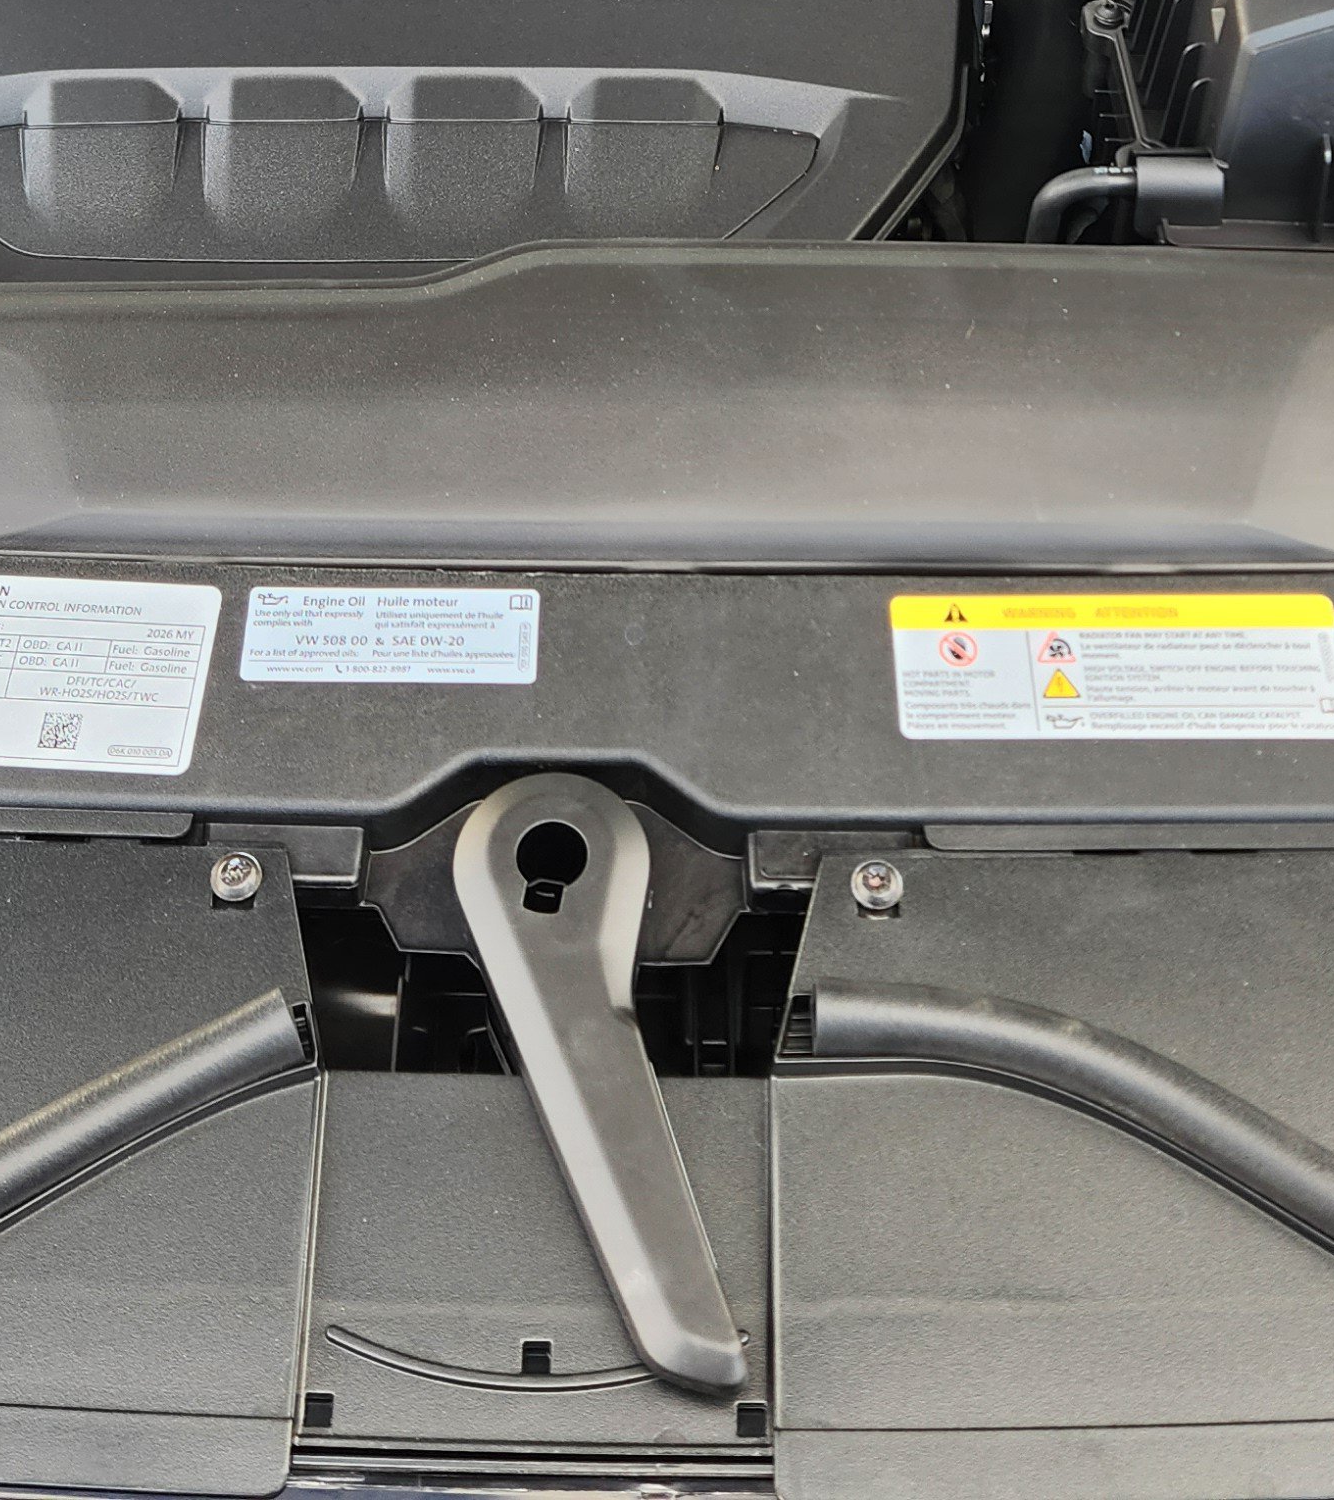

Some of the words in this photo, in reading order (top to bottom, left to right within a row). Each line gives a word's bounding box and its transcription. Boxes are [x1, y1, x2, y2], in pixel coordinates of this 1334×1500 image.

[9, 600, 60, 612] CONTROL
[64, 603, 142, 616] INFORMATION
[303, 596, 345, 609] Engine
[348, 596, 366, 606] Oil
[377, 596, 409, 607] Huile
[413, 598, 459, 607] moteur
[272, 610, 291, 618] only
[325, 611, 363, 620] expressly
[410, 612, 463, 621] uniquement
[253, 620, 291, 629] complies
[375, 621, 389, 630] qui
[391, 620, 425, 629] satisfait
[428, 621, 487, 630] expressément
[489, 621, 495, 629] à
[147, 628, 173, 639] 2026
[176, 630, 195, 639] MY
[295, 635, 319, 645] VW
[323, 635, 347, 645] 508
[351, 636, 368, 645] 00
[375, 637, 385, 645] &
[392, 636, 417, 646] SAE
[420, 636, 465, 646] 0W-20
[23, 639, 50, 650] OBD:
[57, 641, 71, 651] CA
[113, 644, 137, 655] Fuel:
[144, 646, 190, 658] Gasoline
[299, 650, 340, 660] approved
[373, 650, 392, 658] Pour
[411, 650, 429, 658] liste
[19, 655, 46, 666] OBD:
[53, 657, 67, 667] CA
[109, 660, 134, 671] Fuel:
[140, 662, 187, 674] Gasoline
[67, 676, 136, 689] DFI/TC/CAC/
